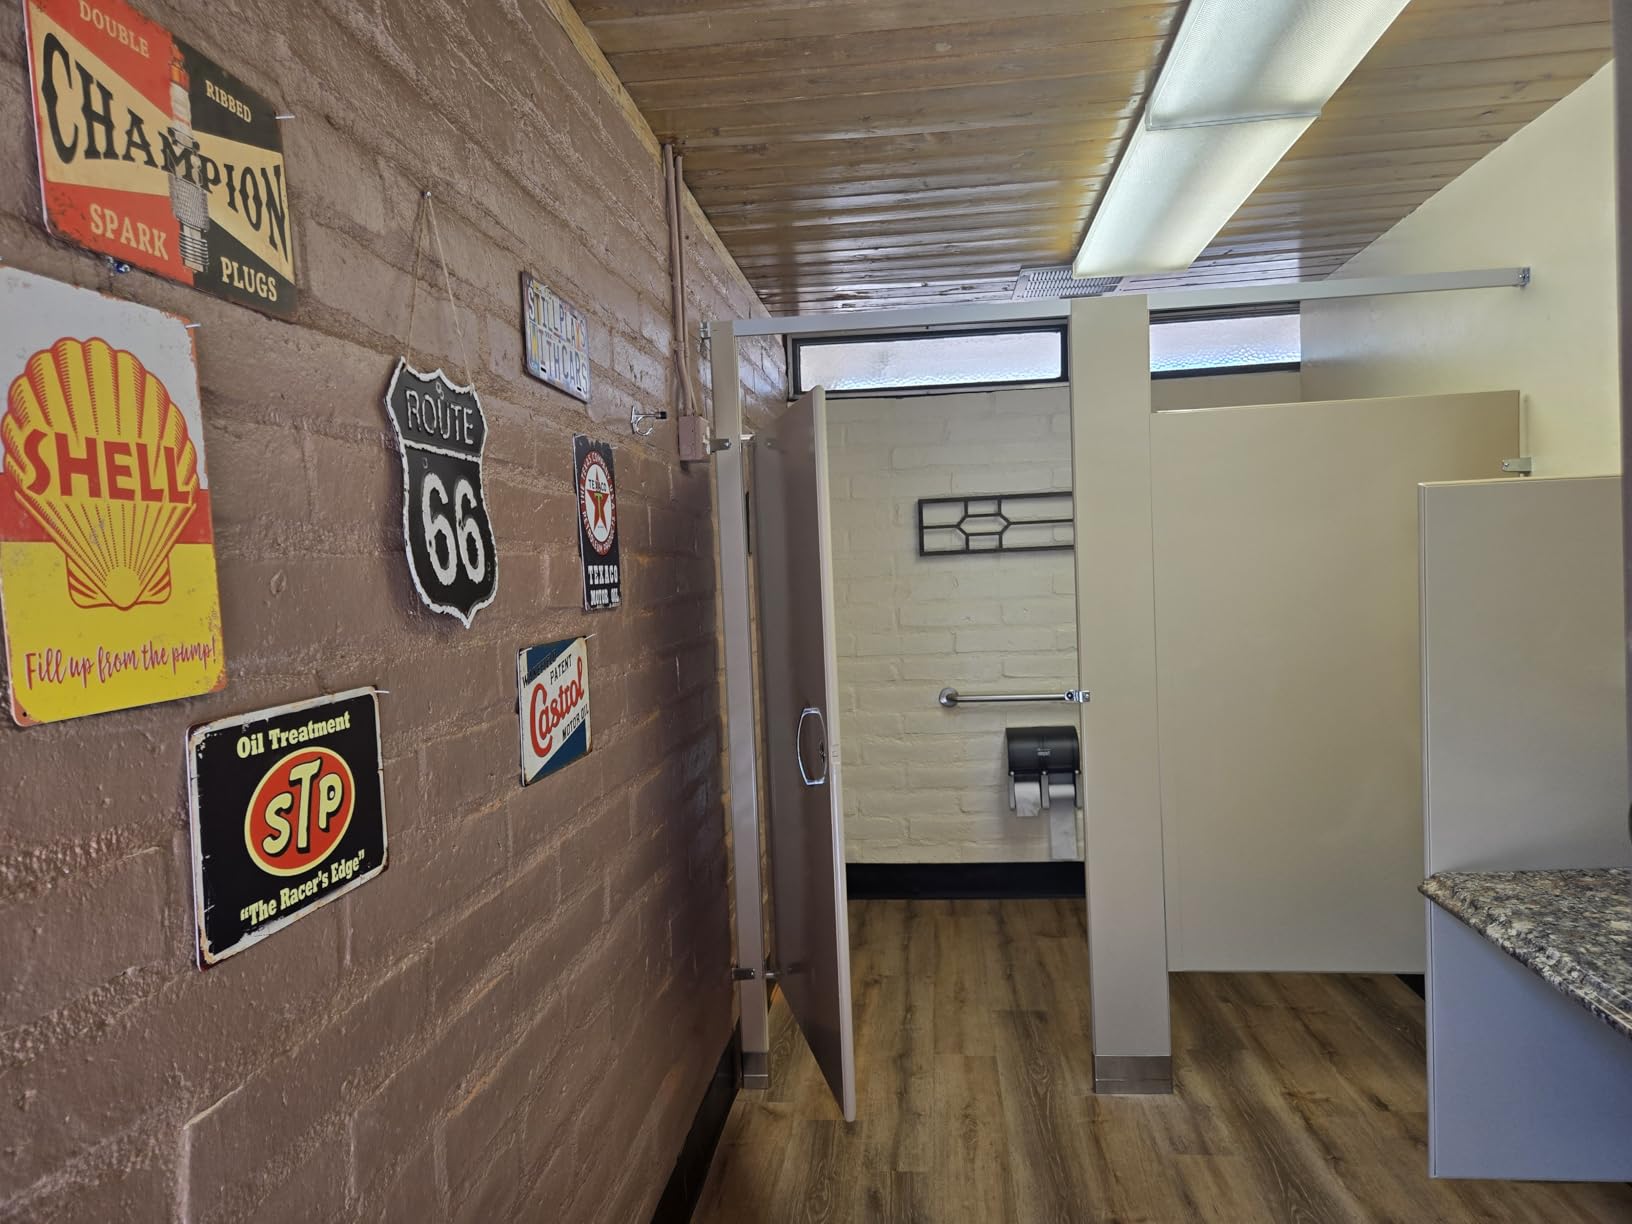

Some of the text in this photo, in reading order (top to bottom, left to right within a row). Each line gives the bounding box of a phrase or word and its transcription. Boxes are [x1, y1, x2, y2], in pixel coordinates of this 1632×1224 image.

[79, 0, 251, 123] DOUBLE RIBBED
[41, 32, 288, 264] CHAMPION
[89, 203, 278, 302] SPARK PLUGS
[406, 390, 474, 444] ROUTE
[24, 428, 191, 504] SHELL
[422, 472, 485, 586] 66
[588, 565, 618, 585] TEXACO
[25, 636, 216, 690] Fill up from the pump!
[550, 653, 572, 685] PATENT
[236, 711, 351, 759] Oil Treatment
[530, 656, 585, 757] Castrol
[562, 704, 590, 742] MOTOR OIL
[262, 757, 344, 855] STP
[280, 868, 329, 910] Racer's
